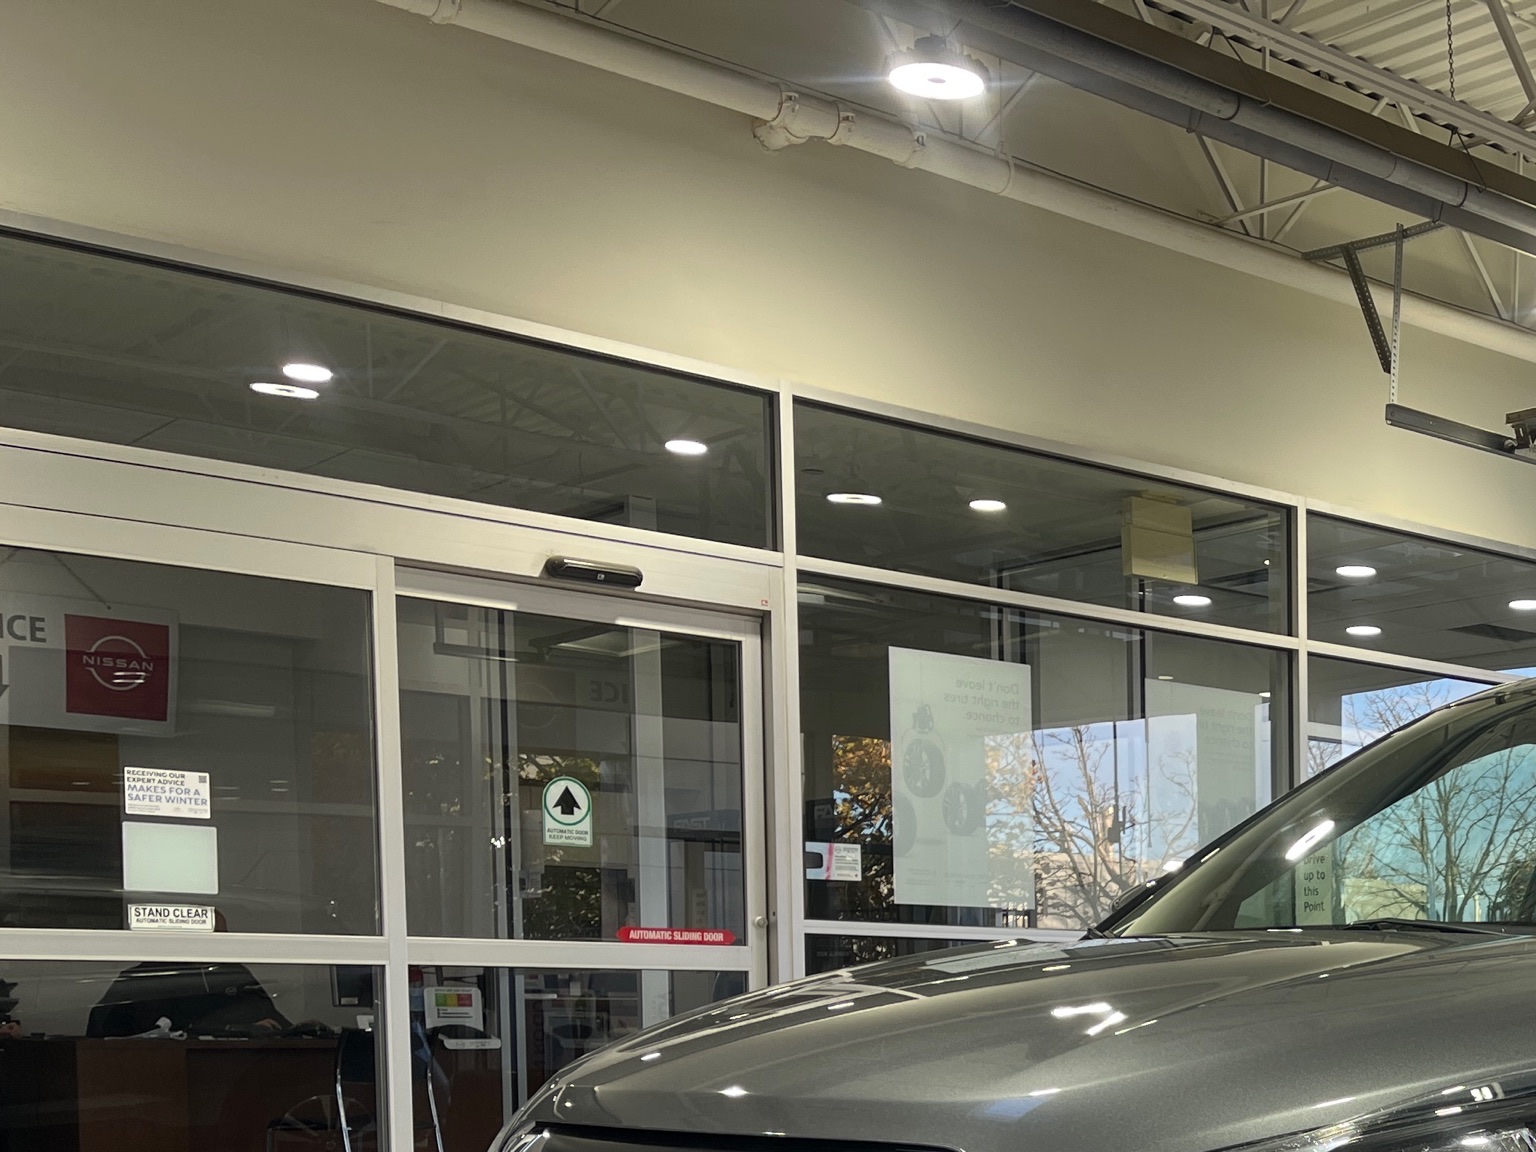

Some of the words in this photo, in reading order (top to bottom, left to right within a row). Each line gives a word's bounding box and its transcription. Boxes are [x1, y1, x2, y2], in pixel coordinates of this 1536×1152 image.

[83, 655, 153, 671] NISSAN
[126, 769, 167, 778] RECEIVING
[157, 778, 186, 786] ADVICE
[127, 784, 167, 793] MAKES
[169, 787, 191, 796] FOR
[193, 788, 201, 796] A
[127, 793, 163, 803] SAFER
[164, 795, 208, 806] WINTER
[1303, 871, 1315, 883] up
[1316, 870, 1326, 880] to
[1303, 886, 1319, 896] this
[1303, 901, 1325, 912] Point
[134, 907, 171, 918] STAND
[172, 908, 209, 919] CLEAR
[629, 929, 672, 940] AUTOMATIC
[673, 931, 702, 941] SLIDING
[703, 932, 724, 942] DOOR
